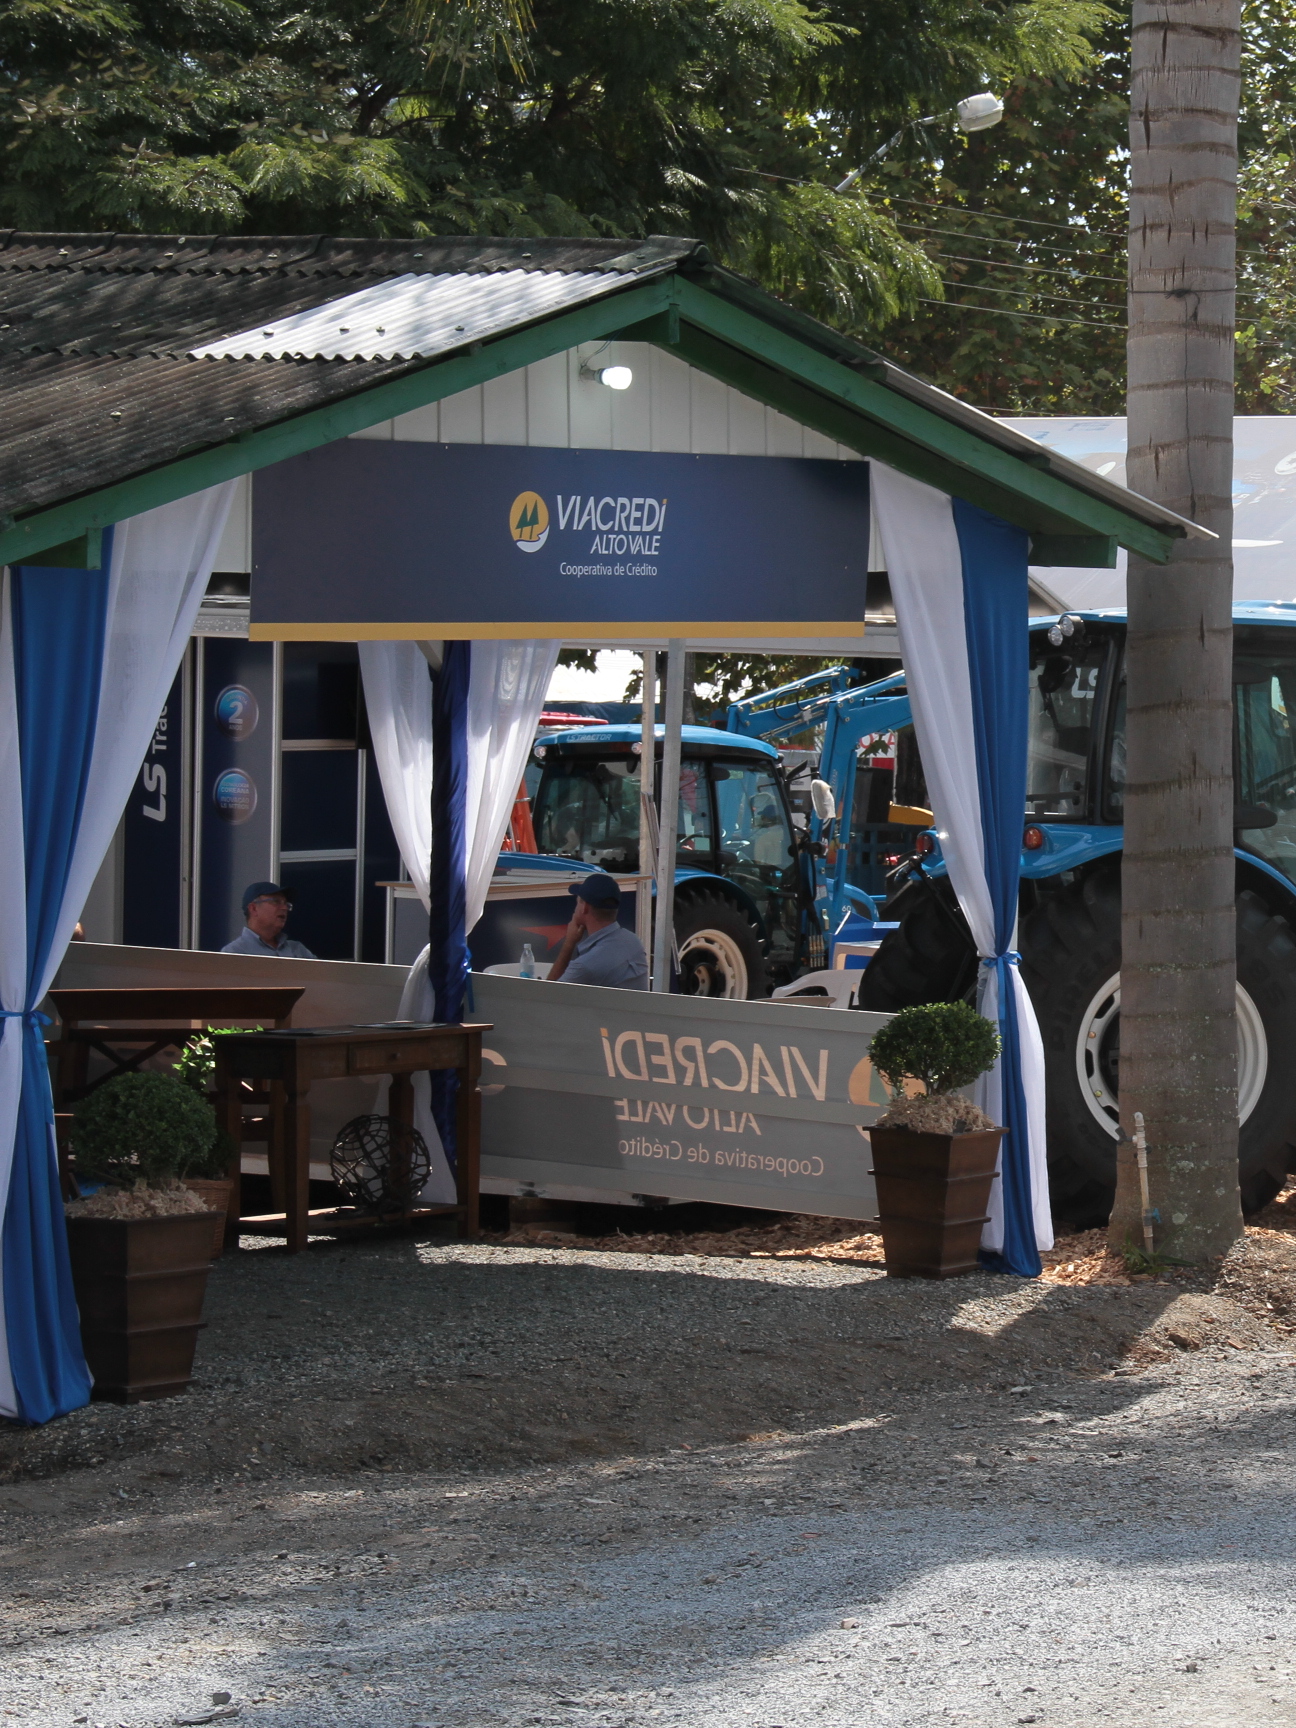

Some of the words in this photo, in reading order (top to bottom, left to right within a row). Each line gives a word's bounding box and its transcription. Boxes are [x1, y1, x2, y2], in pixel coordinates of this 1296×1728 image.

[590, 534, 627, 555] ALTO
[629, 534, 661, 555] VALE
[560, 562, 612, 578] Cooperativa
[613, 562, 625, 576] de
[626, 562, 658, 576] Crédito
[228, 701, 244, 724] 2
[576, 733, 613, 741] TRACTOR
[143, 762, 167, 822] LS
